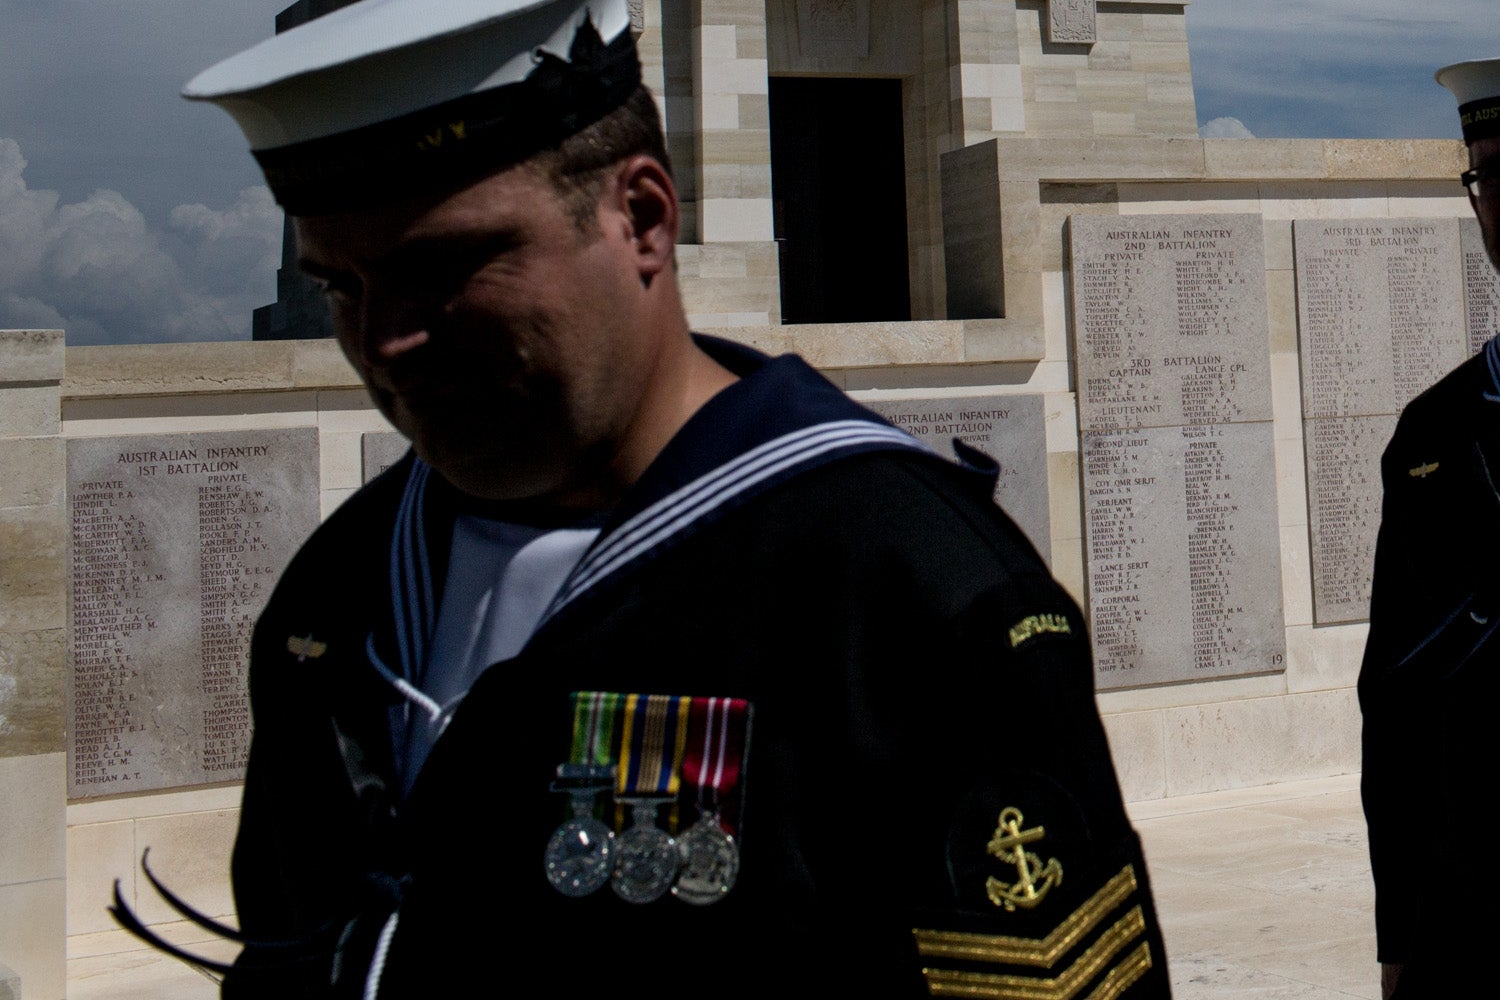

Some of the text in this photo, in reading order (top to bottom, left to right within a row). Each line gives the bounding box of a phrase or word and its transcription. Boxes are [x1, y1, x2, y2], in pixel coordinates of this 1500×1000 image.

[1106, 230, 1232, 240] AUSTRALIAN INFANTRY
[1323, 227, 1436, 236] AUSTRALIAN INFANTRY
[1125, 241, 1216, 251] 2ND BATTALION
[1345, 238, 1419, 246] 3RD BATTALION
[1131, 356, 1221, 368] 3RD BATTALION
[1109, 369, 1151, 377] CAPTAIN
[1195, 364, 1247, 373] LANCE CPL
[1102, 405, 1162, 415] LIEUTENANT
[889, 411, 1009, 424] AUSTRALIAN INFANTRY
[908, 423, 992, 435] 2ND BATTALION
[1127, 439, 1149, 447] LIEUT
[119, 446, 269, 464] AUSTRALIAN INFANTRY
[139, 461, 238, 476] 1ST BATTALION
[208, 474, 247, 483] PRIVATE
[82, 481, 123, 490] PRIVATE
[200, 508, 246, 516] ROBERTSON
[1128, 562, 1149, 570] SERJT
[1102, 596, 1140, 604] CORPORAL
[1272, 654, 1283, 665] 19
[204, 707, 248, 717] THOMPSON
[76, 774, 117, 785] RENEHAN
